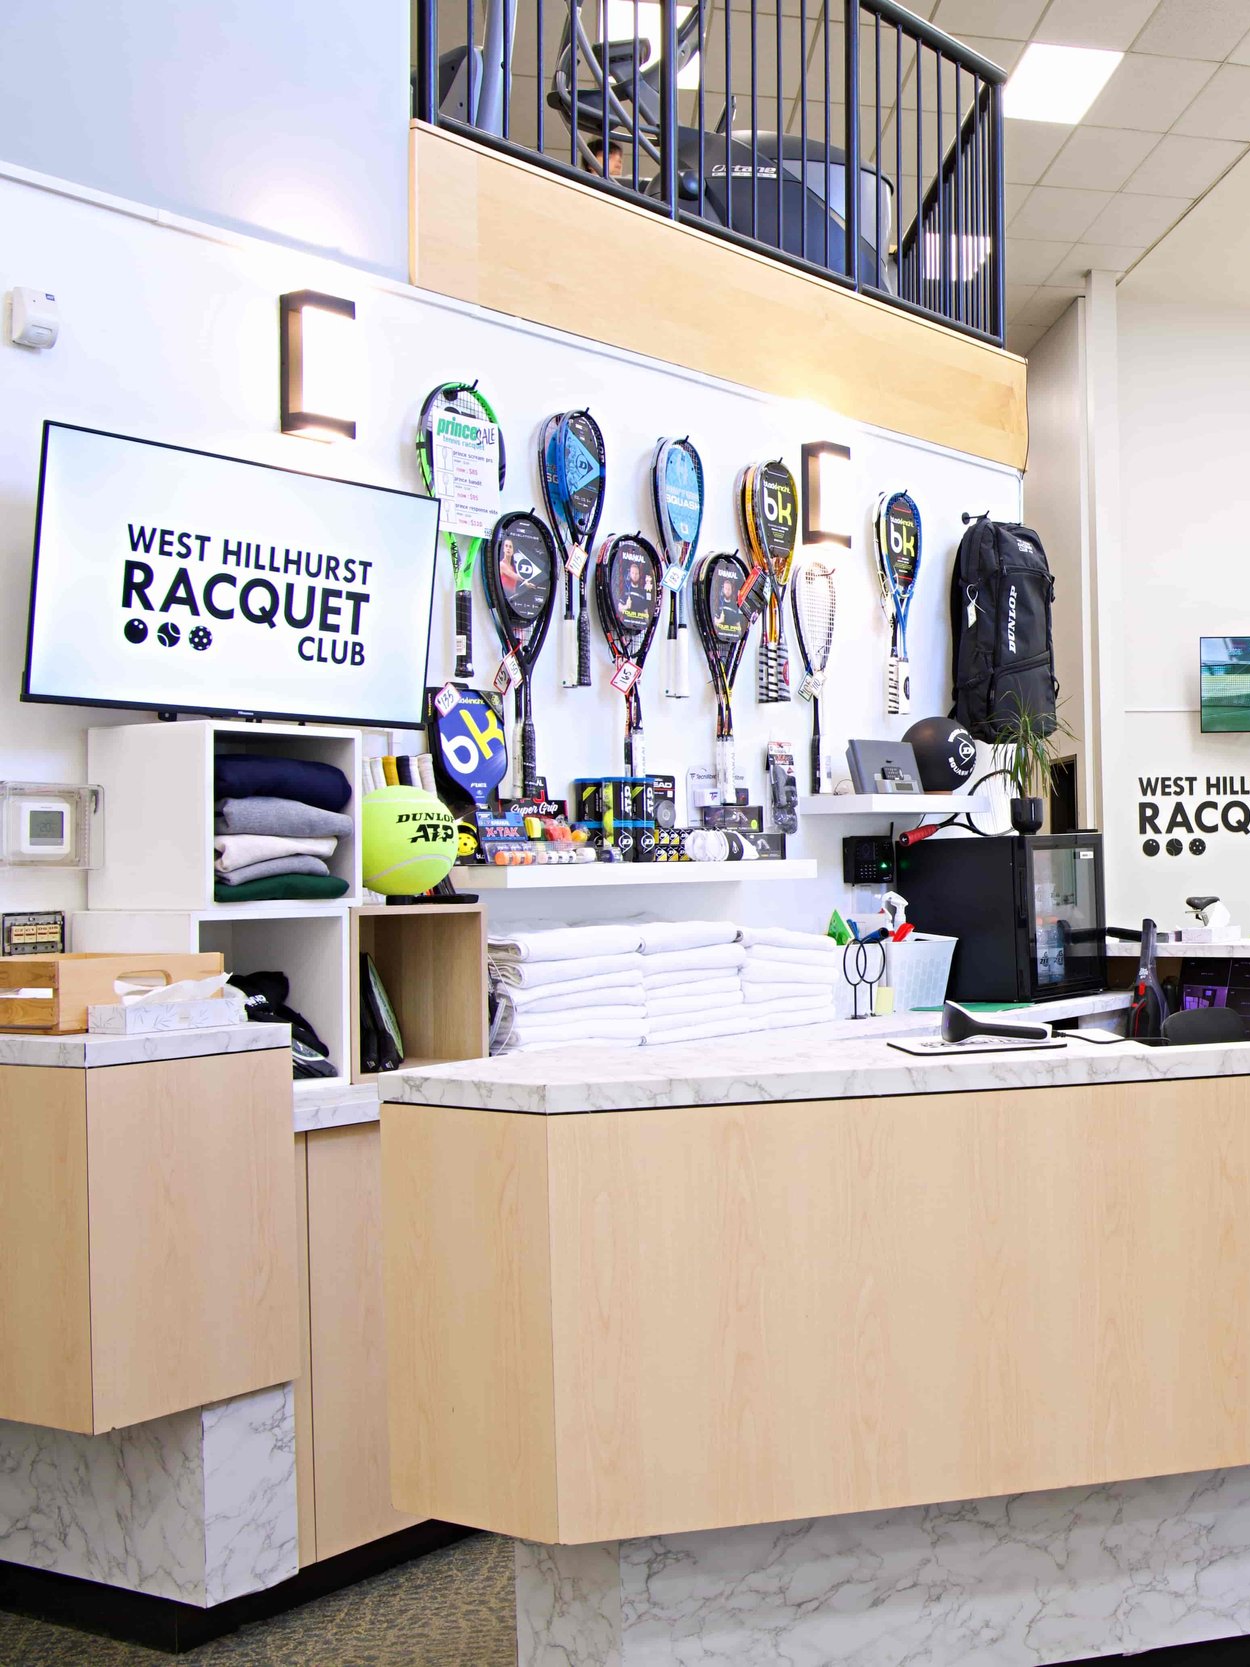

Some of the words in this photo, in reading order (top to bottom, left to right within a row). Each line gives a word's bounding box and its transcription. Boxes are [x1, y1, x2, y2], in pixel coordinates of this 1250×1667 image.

[436, 416, 478, 441] prince
[476, 427, 495, 445] SALE
[763, 486, 792, 526] bk
[127, 523, 211, 562] WEST
[222, 538, 373, 585] HILLHURST
[890, 522, 915, 557] bk
[121, 559, 370, 635] RACQUET
[1007, 585, 1018, 654] DUNLOP
[297, 635, 366, 667] CLUB
[440, 709, 504, 775] bk
[1138, 776, 1197, 796] WEST
[396, 812, 455, 824] DUNLOP
[538, 801, 559, 815] Grip
[408, 823, 454, 844] ATP
